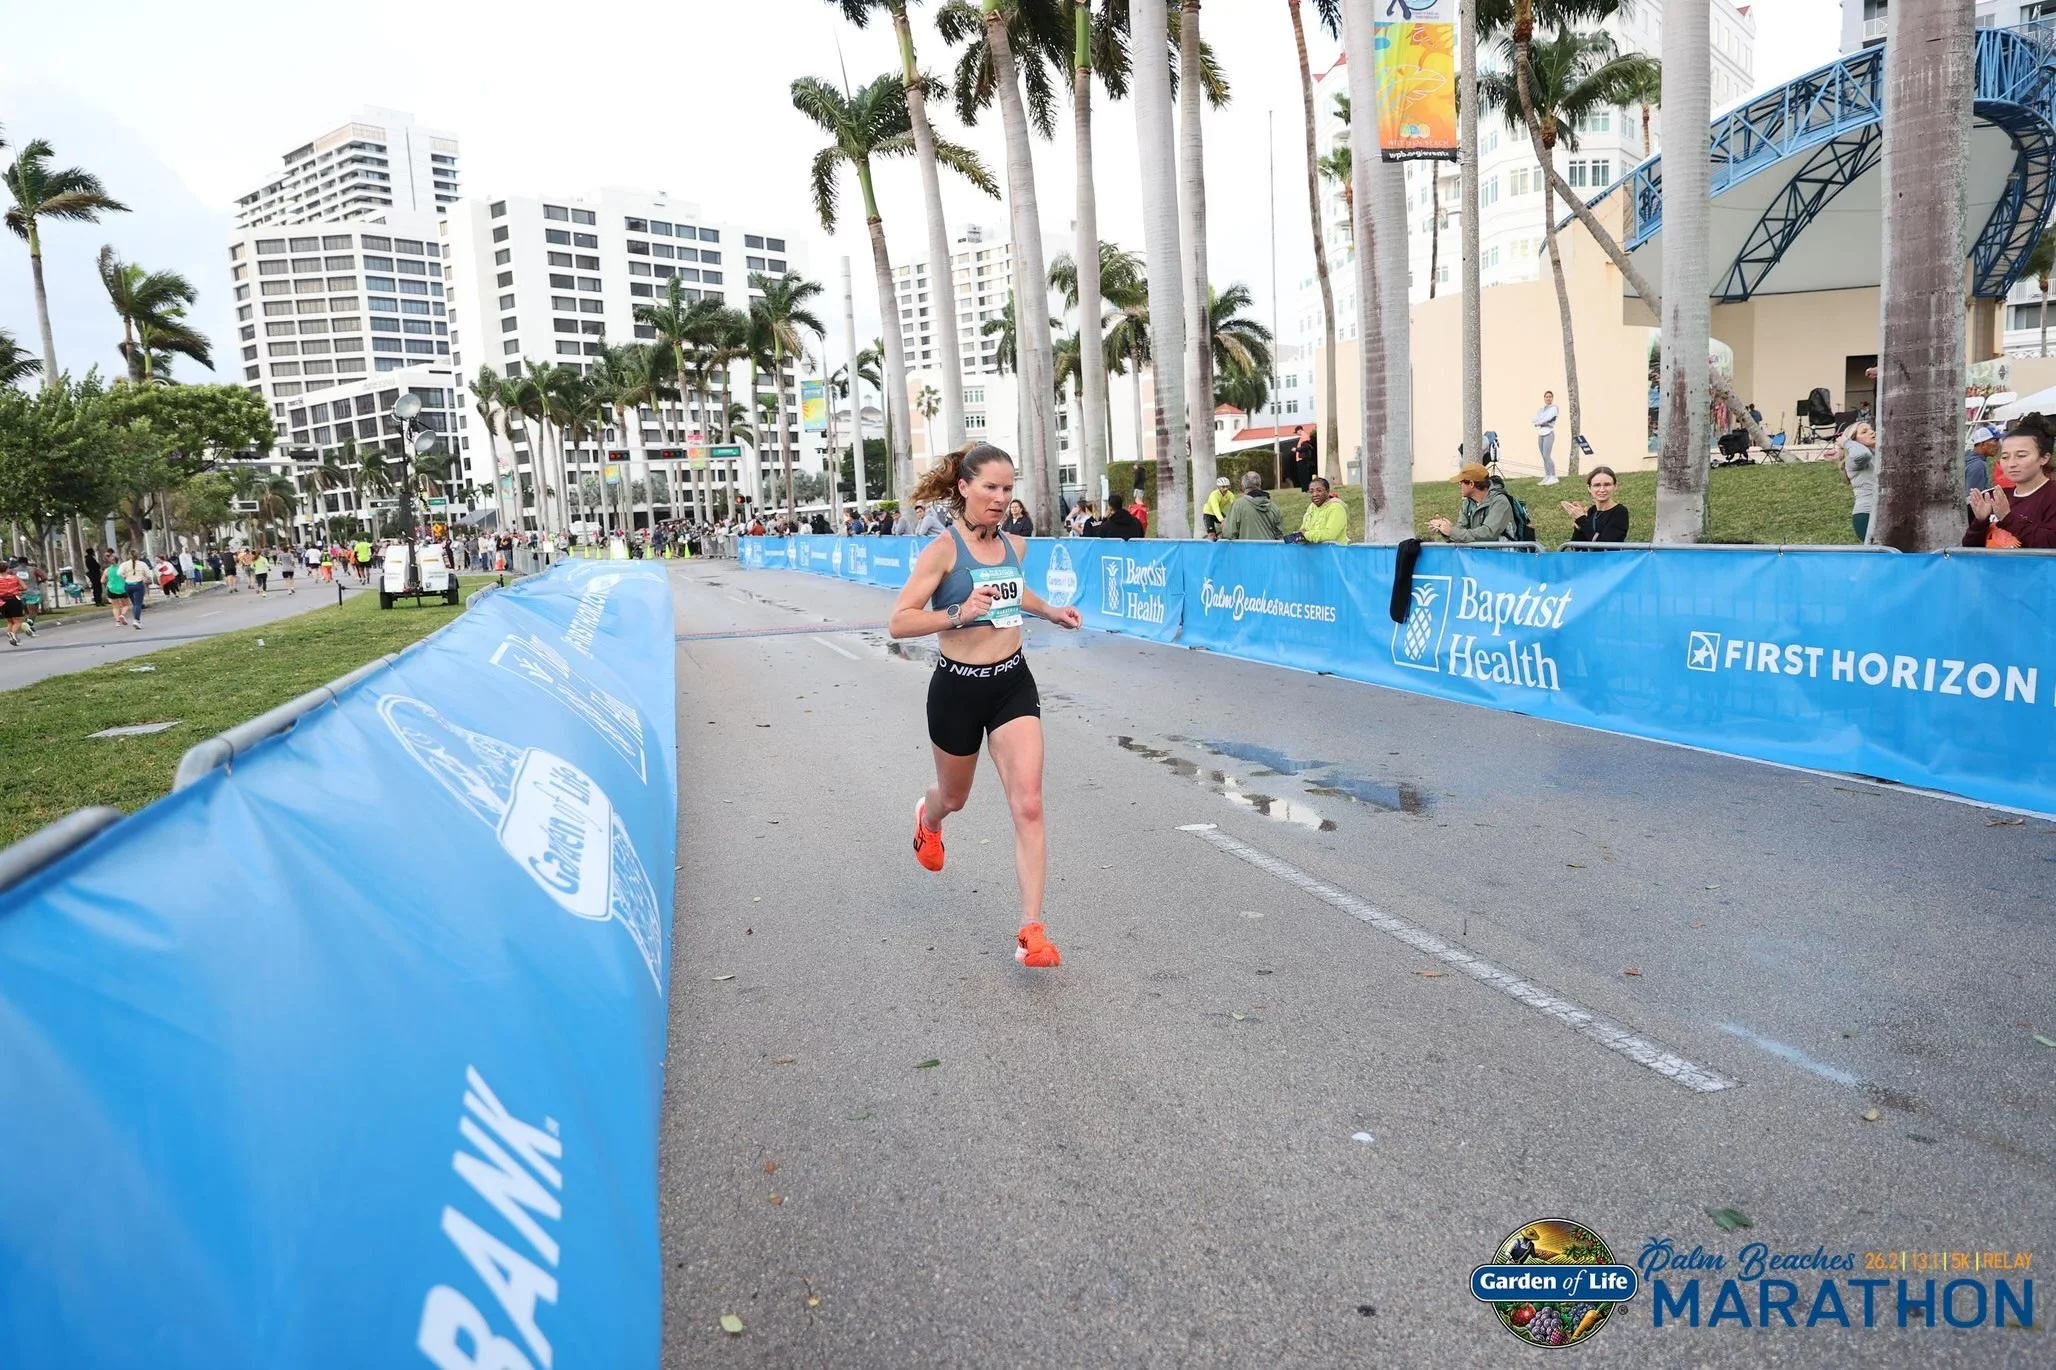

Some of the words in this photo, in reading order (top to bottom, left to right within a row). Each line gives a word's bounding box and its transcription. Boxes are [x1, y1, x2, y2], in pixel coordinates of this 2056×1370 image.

[1125, 557, 1166, 592] Baptist
[1201, 577, 1233, 616] Palm
[1232, 584, 1280, 621] Beaches
[1279, 601, 1302, 618] RACE
[1304, 604, 1336, 622] SERIES
[1127, 592, 1165, 624] Health
[1456, 576, 1572, 636] Baptist
[949, 664, 993, 677] NIKE
[994, 654, 1020, 676] PRO
[1448, 633, 1561, 691] Health
[1724, 638, 1824, 678] FIRST
[1831, 649, 2038, 704] HORIZON
[417, 1063, 563, 1370] BANK
